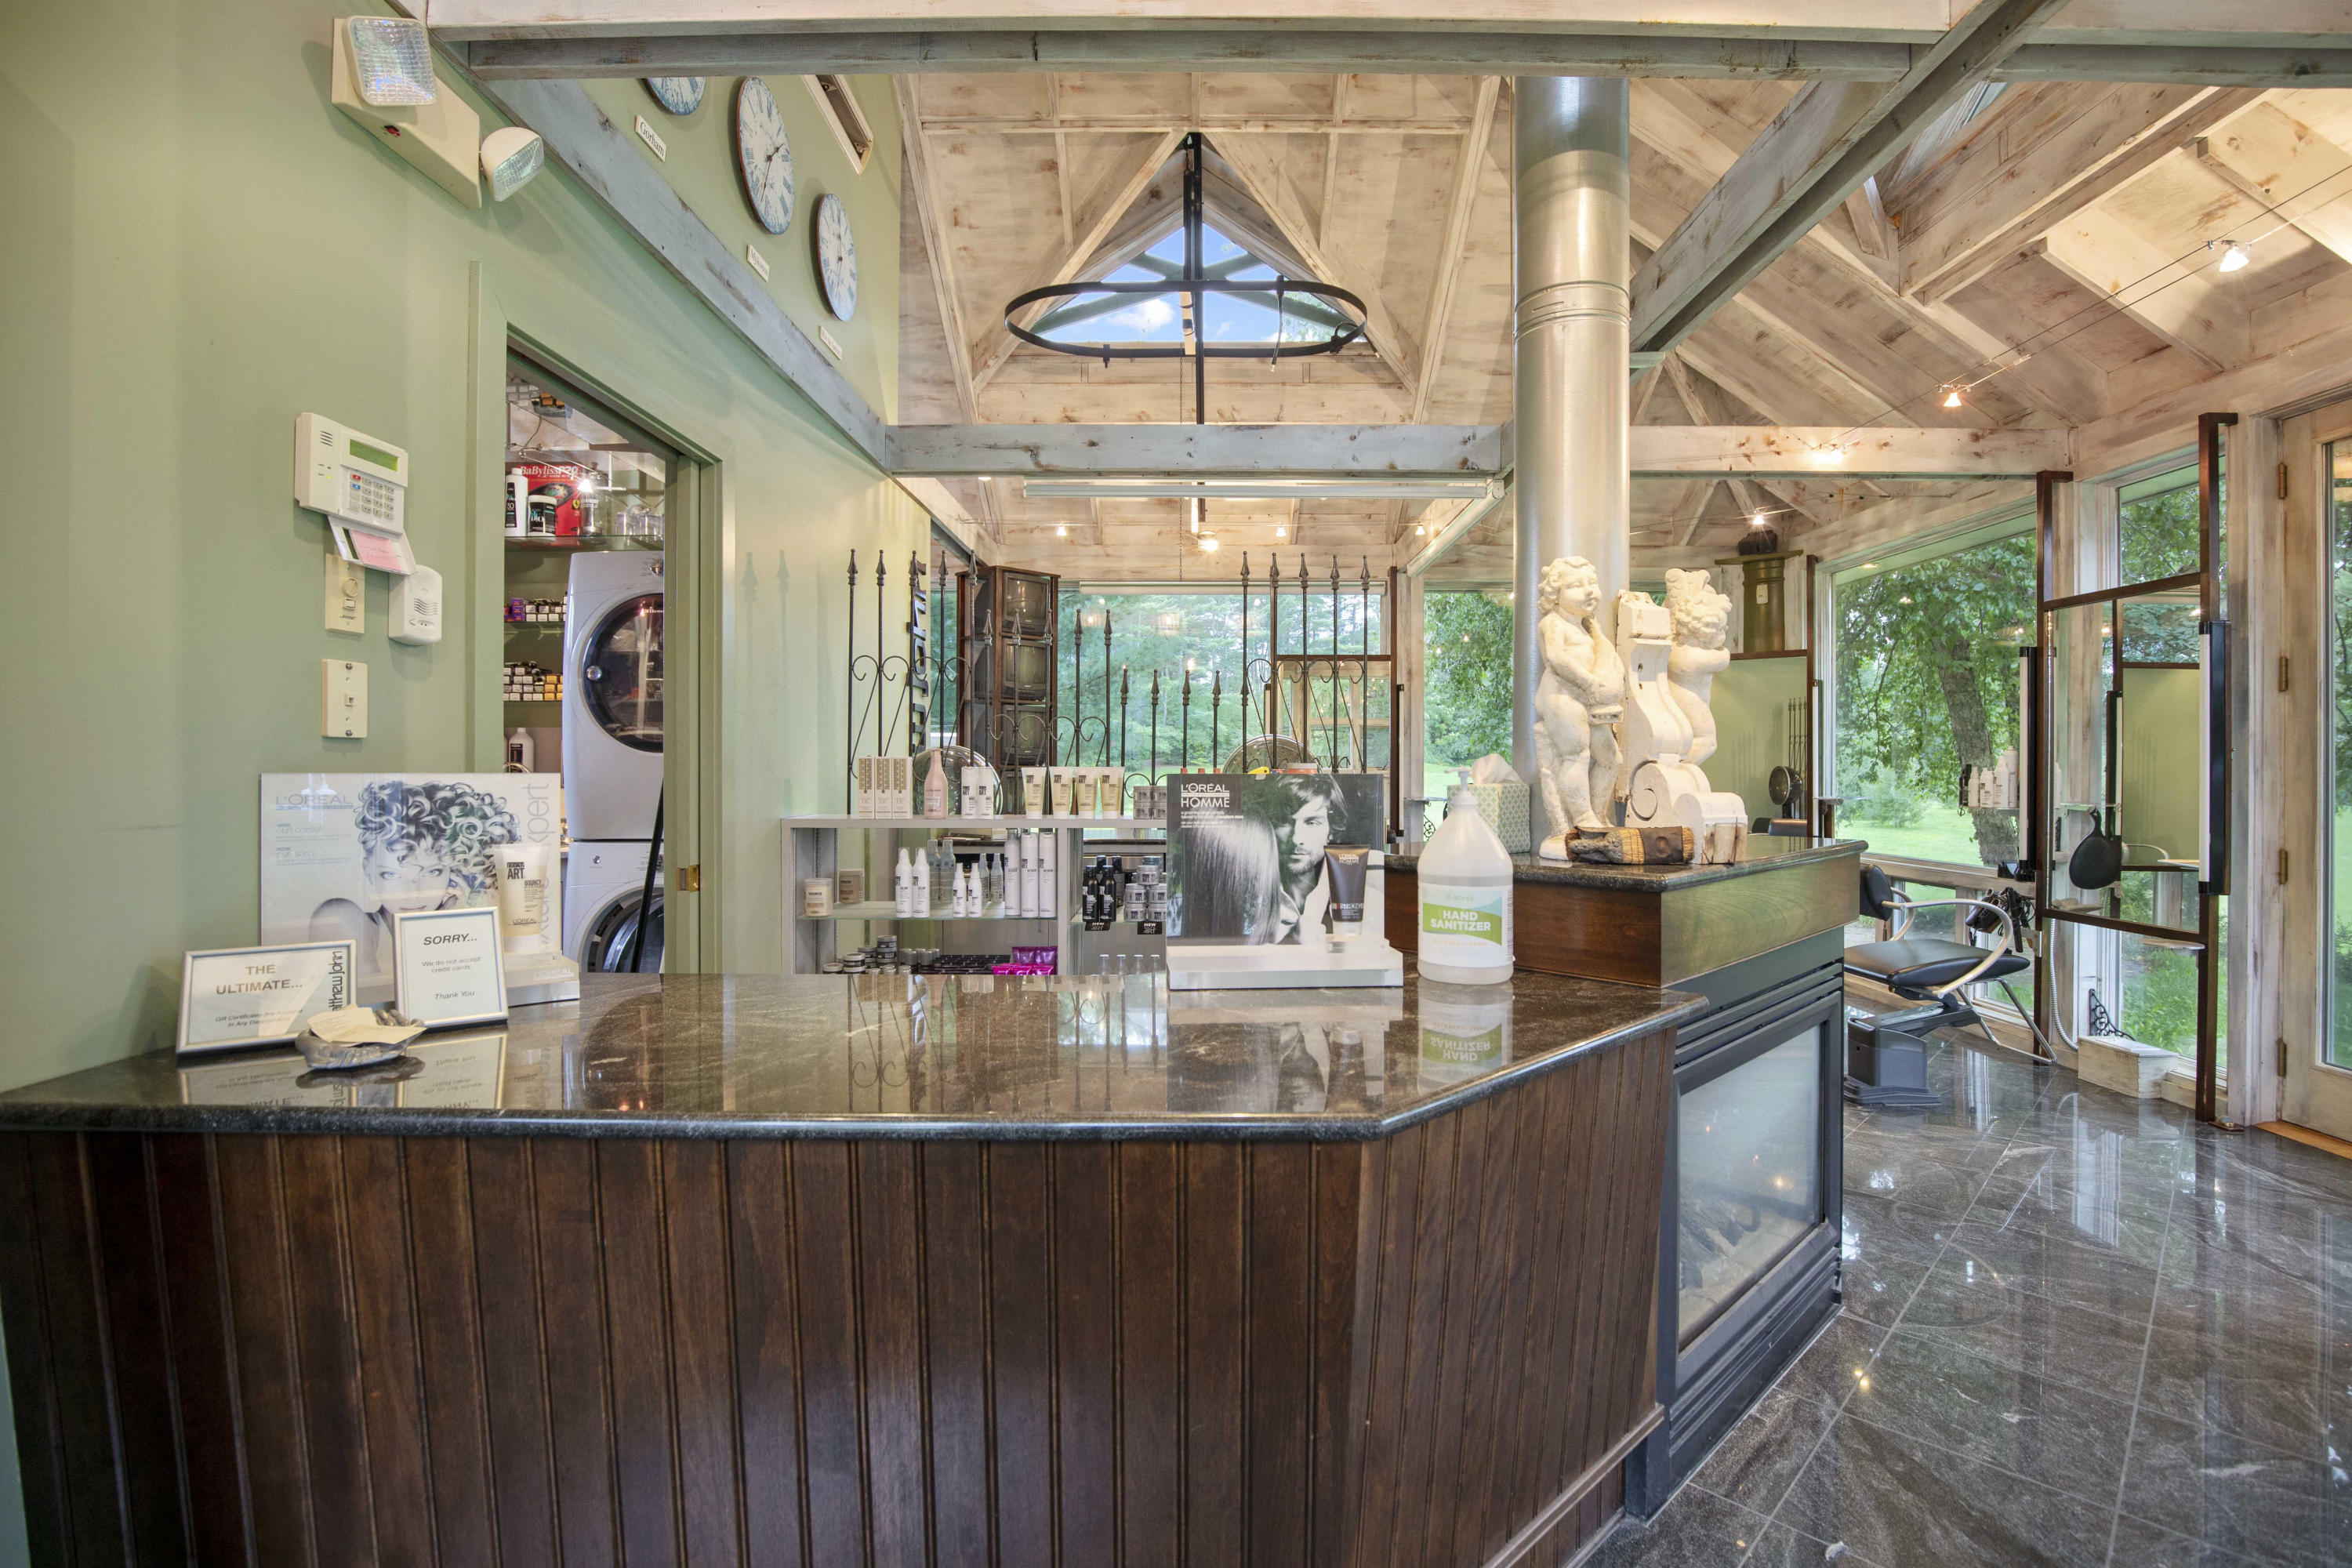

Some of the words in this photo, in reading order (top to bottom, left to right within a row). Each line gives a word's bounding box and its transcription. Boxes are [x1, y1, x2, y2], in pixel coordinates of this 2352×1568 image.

[640, 122, 664, 157] Gorham
[1181, 782, 1230, 793] L'ORÉAL
[1181, 797, 1230, 808] HOMME
[507, 868, 524, 880] ART
[1443, 909, 1479, 921] HAND
[1430, 918, 1492, 931] SANITIZER
[423, 934, 477, 946] SORRY...
[246, 965, 275, 975] THE
[216, 979, 303, 995] ULTIMATE...
